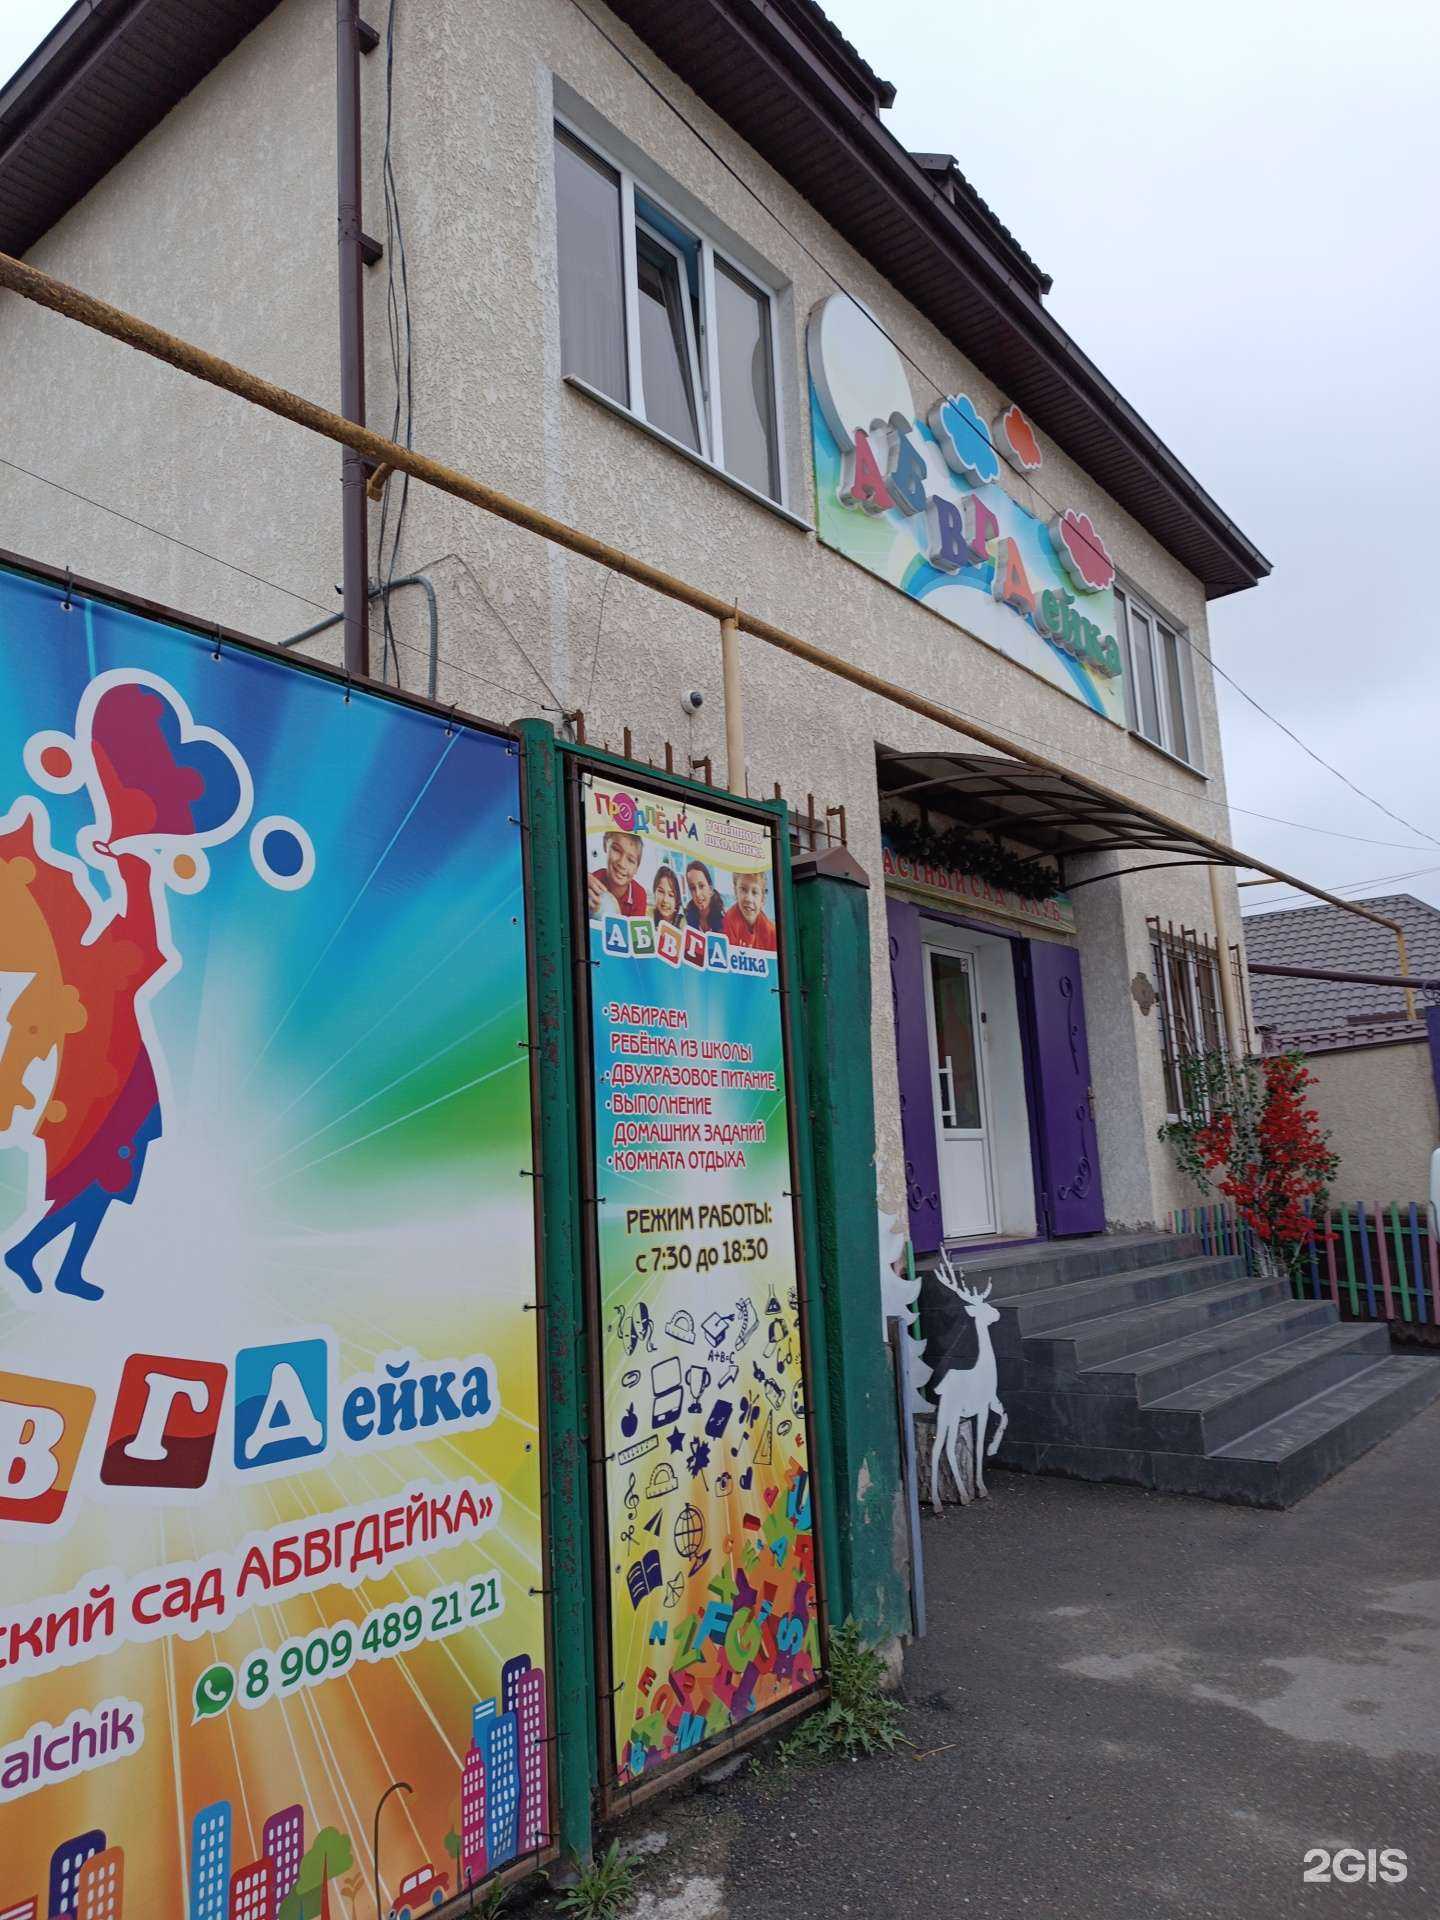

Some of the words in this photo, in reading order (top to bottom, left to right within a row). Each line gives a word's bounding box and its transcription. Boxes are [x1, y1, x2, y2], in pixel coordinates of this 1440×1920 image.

[607, 921, 767, 973] АБВГДейка
[610, 1003, 688, 1028] ЗАБИРАЕМ
[612, 1032, 677, 1056] РЕБЁНКА
[680, 1040, 698, 1057] ИЗ
[702, 1042, 752, 1062] ШКОЛЫ
[612, 1064, 718, 1086] ДВУХРАЗОВОЕ
[722, 1070, 775, 1090] ПИТАНИЕ
[613, 1094, 712, 1115] ВЫПОЛНЕНИЕ
[614, 1123, 700, 1145] ДОМАШНИХ
[705, 1121, 765, 1145] ЗАДАНИЙ
[614, 1151, 685, 1171] КОМНАТА
[689, 1151, 745, 1171] ОТДЫХА
[627, 1206, 694, 1233] РЕЖИМ
[699, 1202, 772, 1229] РАБОТЫ:
[652, 1245, 691, 1271] 7:30
[697, 1248, 718, 1272] до
[723, 1238, 768, 1264] 18:30
[131, 1568, 225, 1623] сад
[237, 1489, 493, 1598] АБВГДЕЙКА»
[245, 1658, 269, 1699] 8
[280, 1629, 352, 1688] 909
[362, 1604, 423, 1656] 489
[431, 1594, 462, 1632] 21
[470, 1577, 499, 1618] 21
[1, 1708, 136, 1789] alchik
